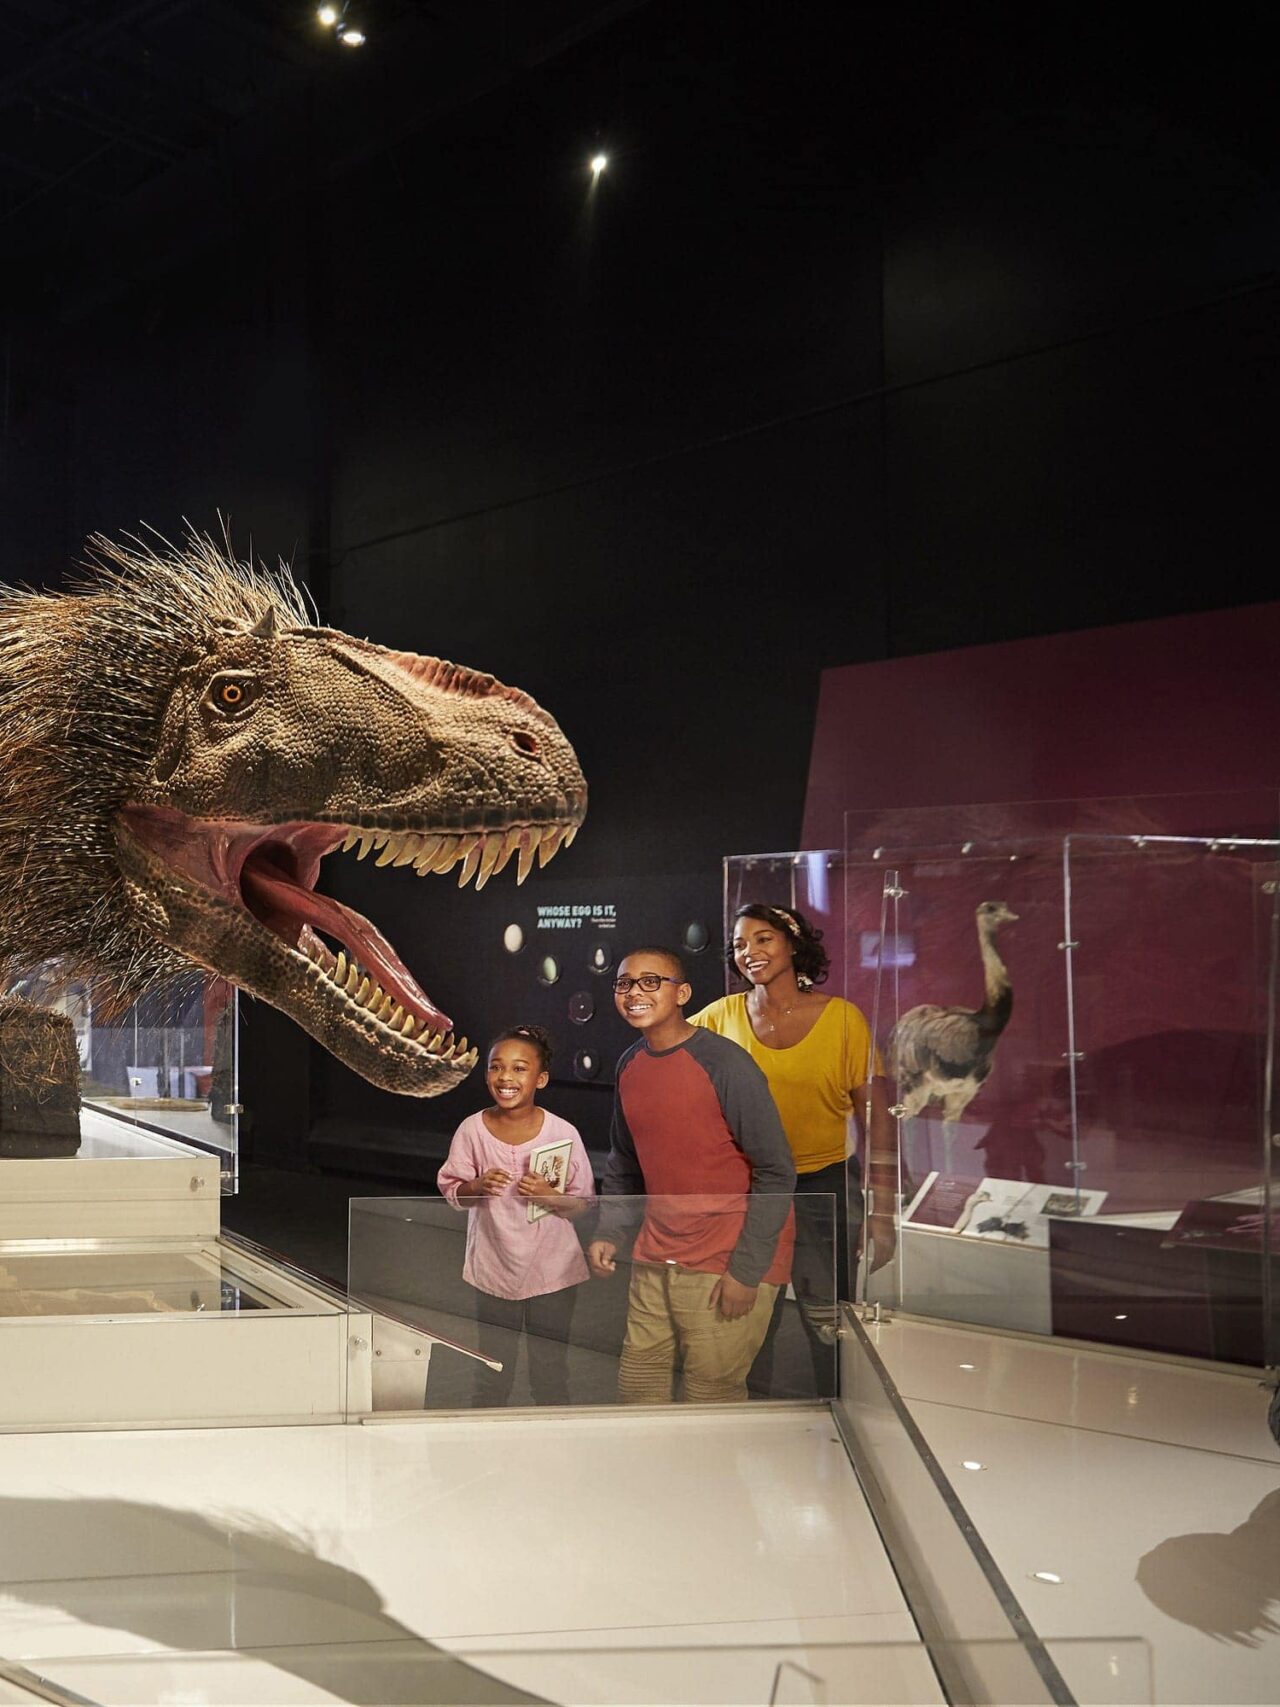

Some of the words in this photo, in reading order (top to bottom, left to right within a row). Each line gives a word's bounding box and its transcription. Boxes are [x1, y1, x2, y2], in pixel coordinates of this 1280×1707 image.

[537, 906, 570, 916] WHOSE
[572, 905, 591, 916] EGG
[593, 905, 603, 916] IS
[604, 905, 616, 917] IT,
[537, 918, 582, 928] ANYWAY?
